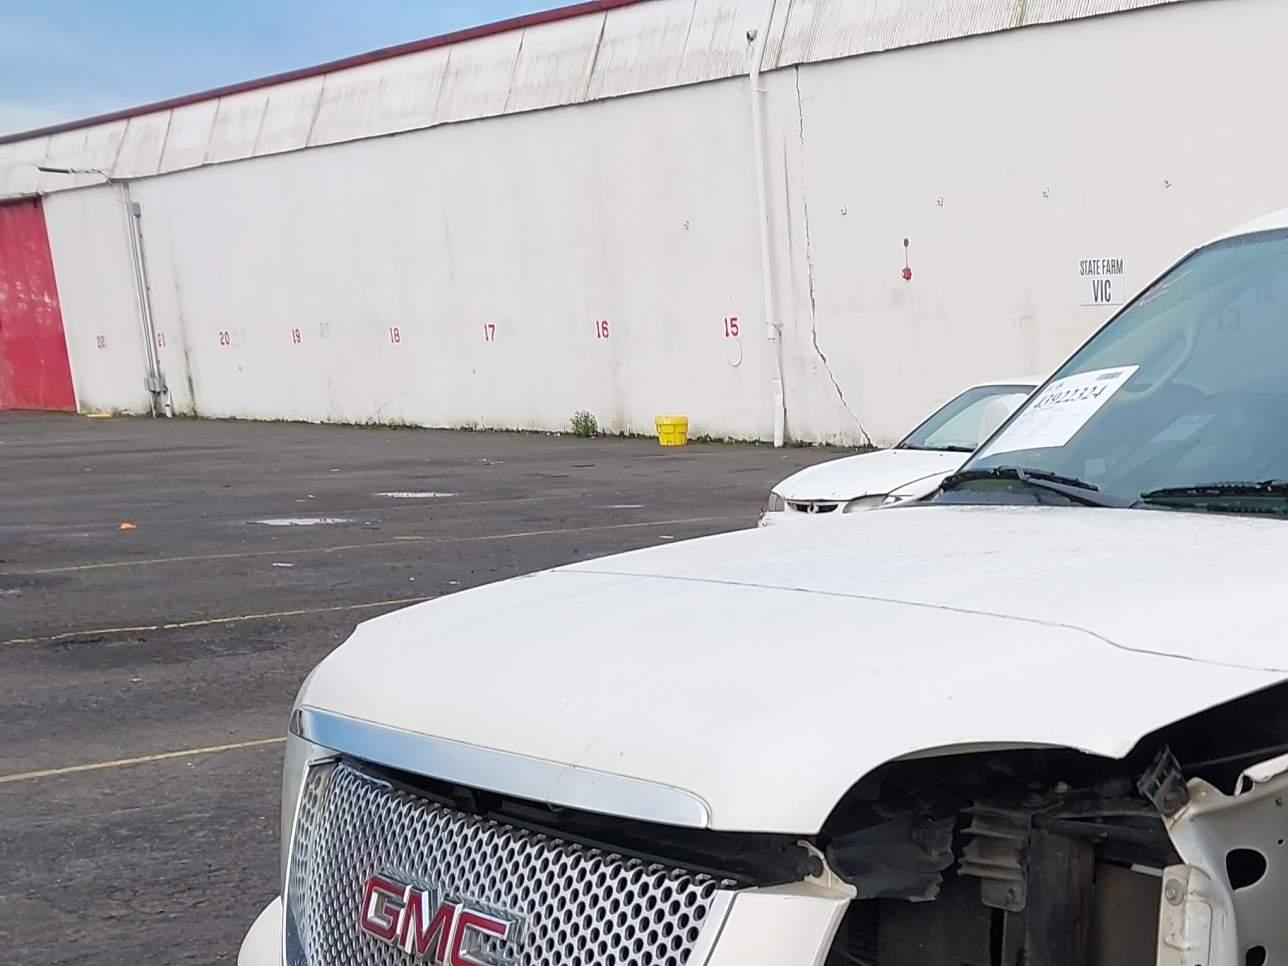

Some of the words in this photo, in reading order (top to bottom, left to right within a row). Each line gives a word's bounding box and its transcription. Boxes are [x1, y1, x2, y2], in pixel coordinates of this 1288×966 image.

[1080, 259, 1101, 275] STATE
[1102, 258, 1123, 275] FARM
[1092, 279, 1111, 302] VIC
[292, 328, 301, 343] 19
[389, 327, 400, 343] 18
[484, 324, 496, 341] 17
[596, 320, 609, 338] 16
[724, 317, 739, 337] 15
[157, 333, 166, 347] 21
[219, 331, 230, 345] 20
